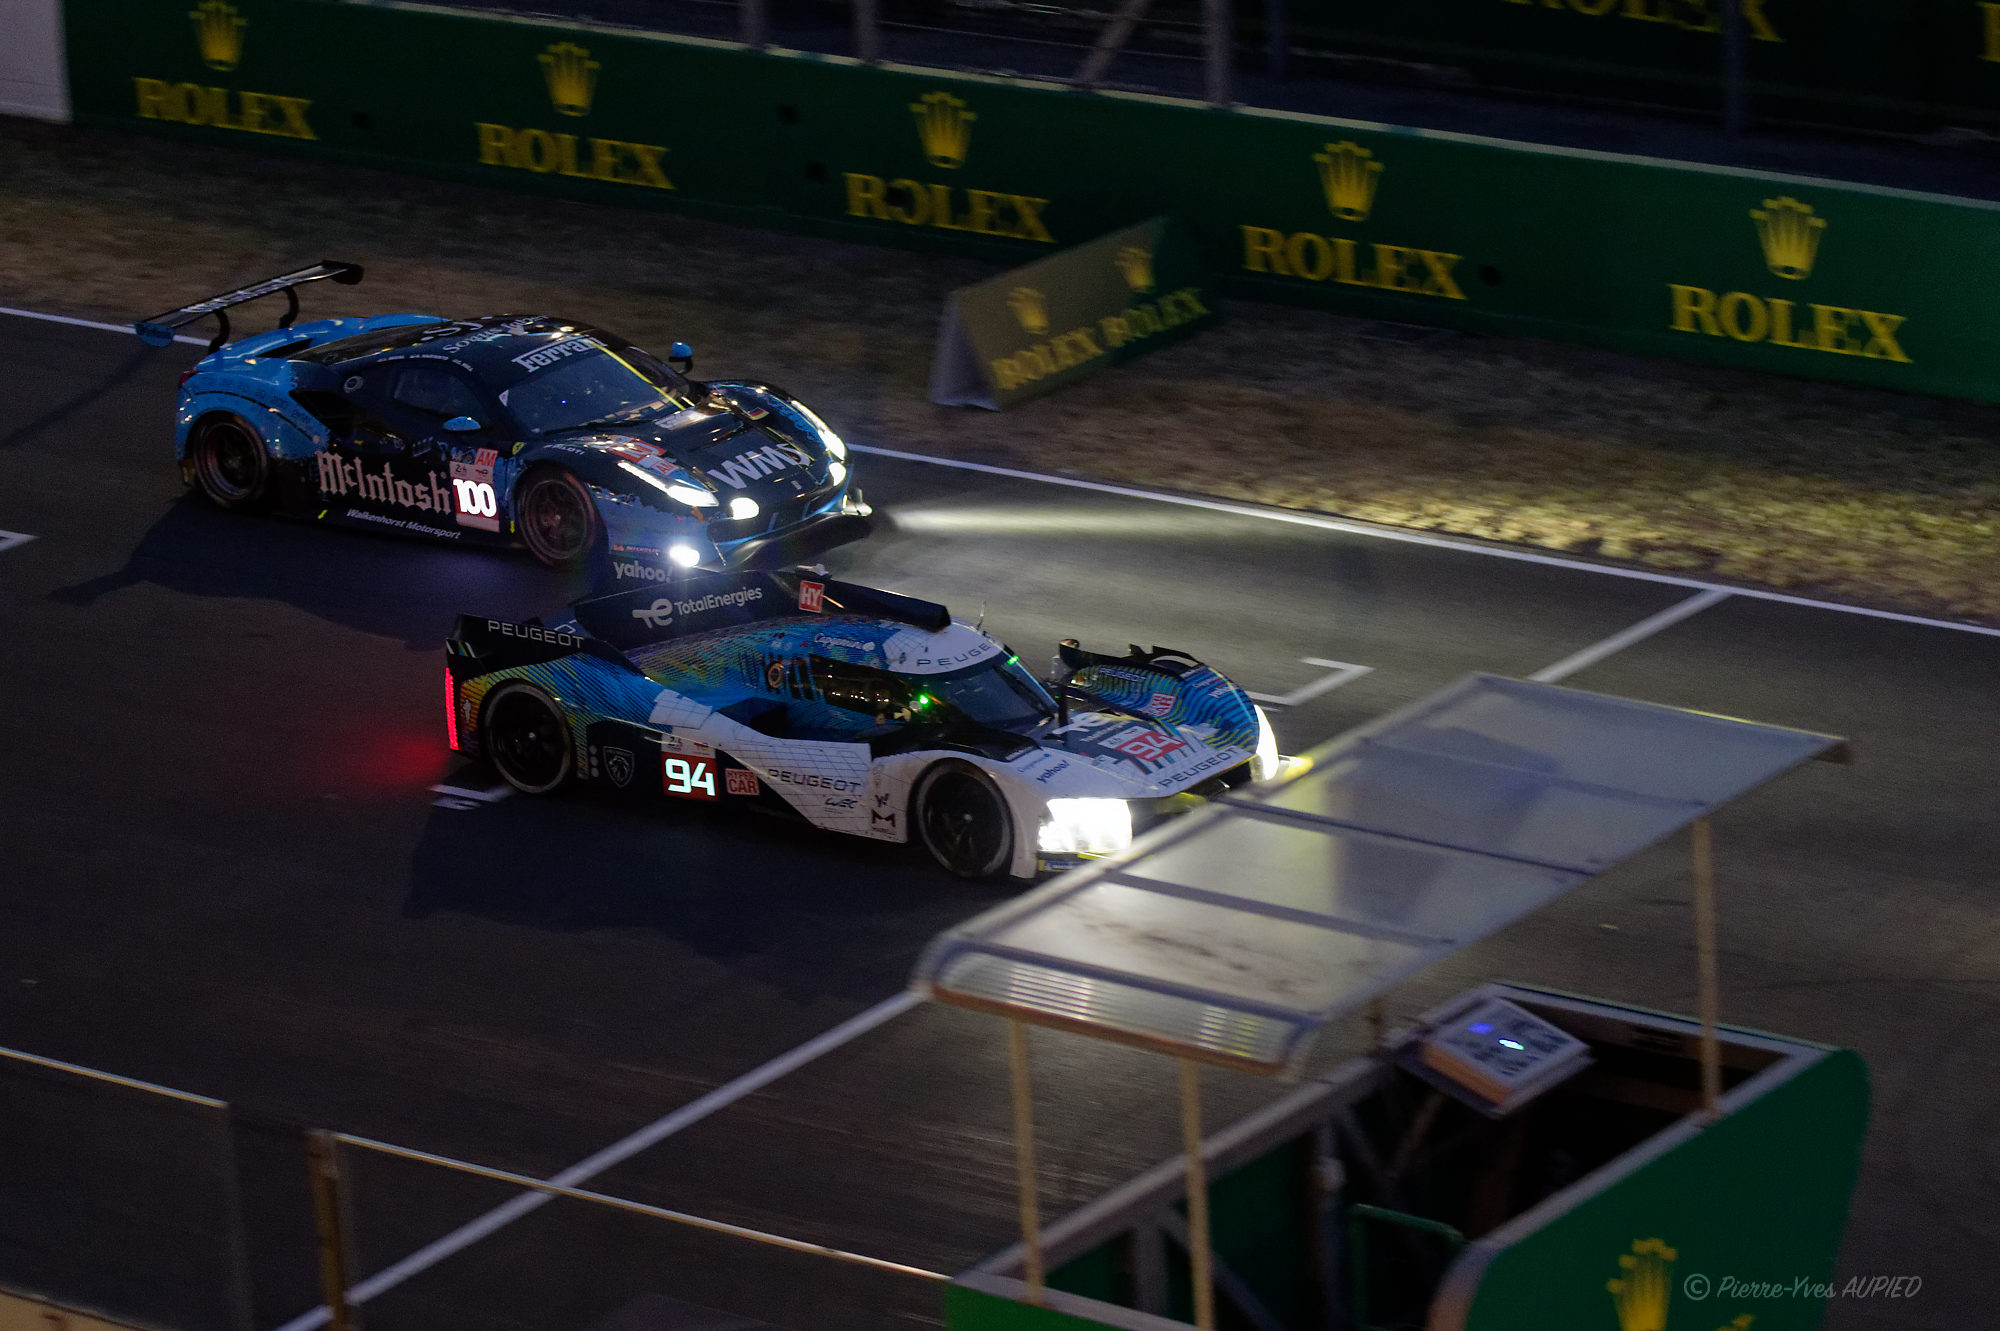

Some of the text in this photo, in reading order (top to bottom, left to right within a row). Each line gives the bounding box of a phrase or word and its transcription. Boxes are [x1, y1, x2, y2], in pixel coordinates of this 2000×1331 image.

[133, 77, 319, 141] ROLEX
[476, 122, 674, 190] ROLEX
[842, 172, 1057, 243] ROLEX
[1239, 225, 1468, 300] ROLEX
[1098, 286, 1210, 346] ROLEX
[1666, 284, 1913, 363] ROLEX
[511, 335, 608, 373] Ferrari
[991, 325, 1103, 389] ROLEX
[476, 452, 496, 467] AM
[315, 450, 452, 515] McIntosh
[453, 478, 497, 518] 100
[346, 508, 461, 540] Walkenhorst Motorsport
[613, 560, 672, 582] yahoo!
[674, 587, 763, 616] TotalEnergies
[801, 587, 822, 606] HY
[487, 619, 584, 649] PEUGEOT
[1121, 735, 1181, 760] 94
[665, 758, 716, 797] 94
[728, 779, 758, 794] CAR
[768, 769, 861, 793] PEUGEOT
[1036, 759, 1070, 784] yahoo!
[1158, 748, 1239, 788] PEUGEOT
